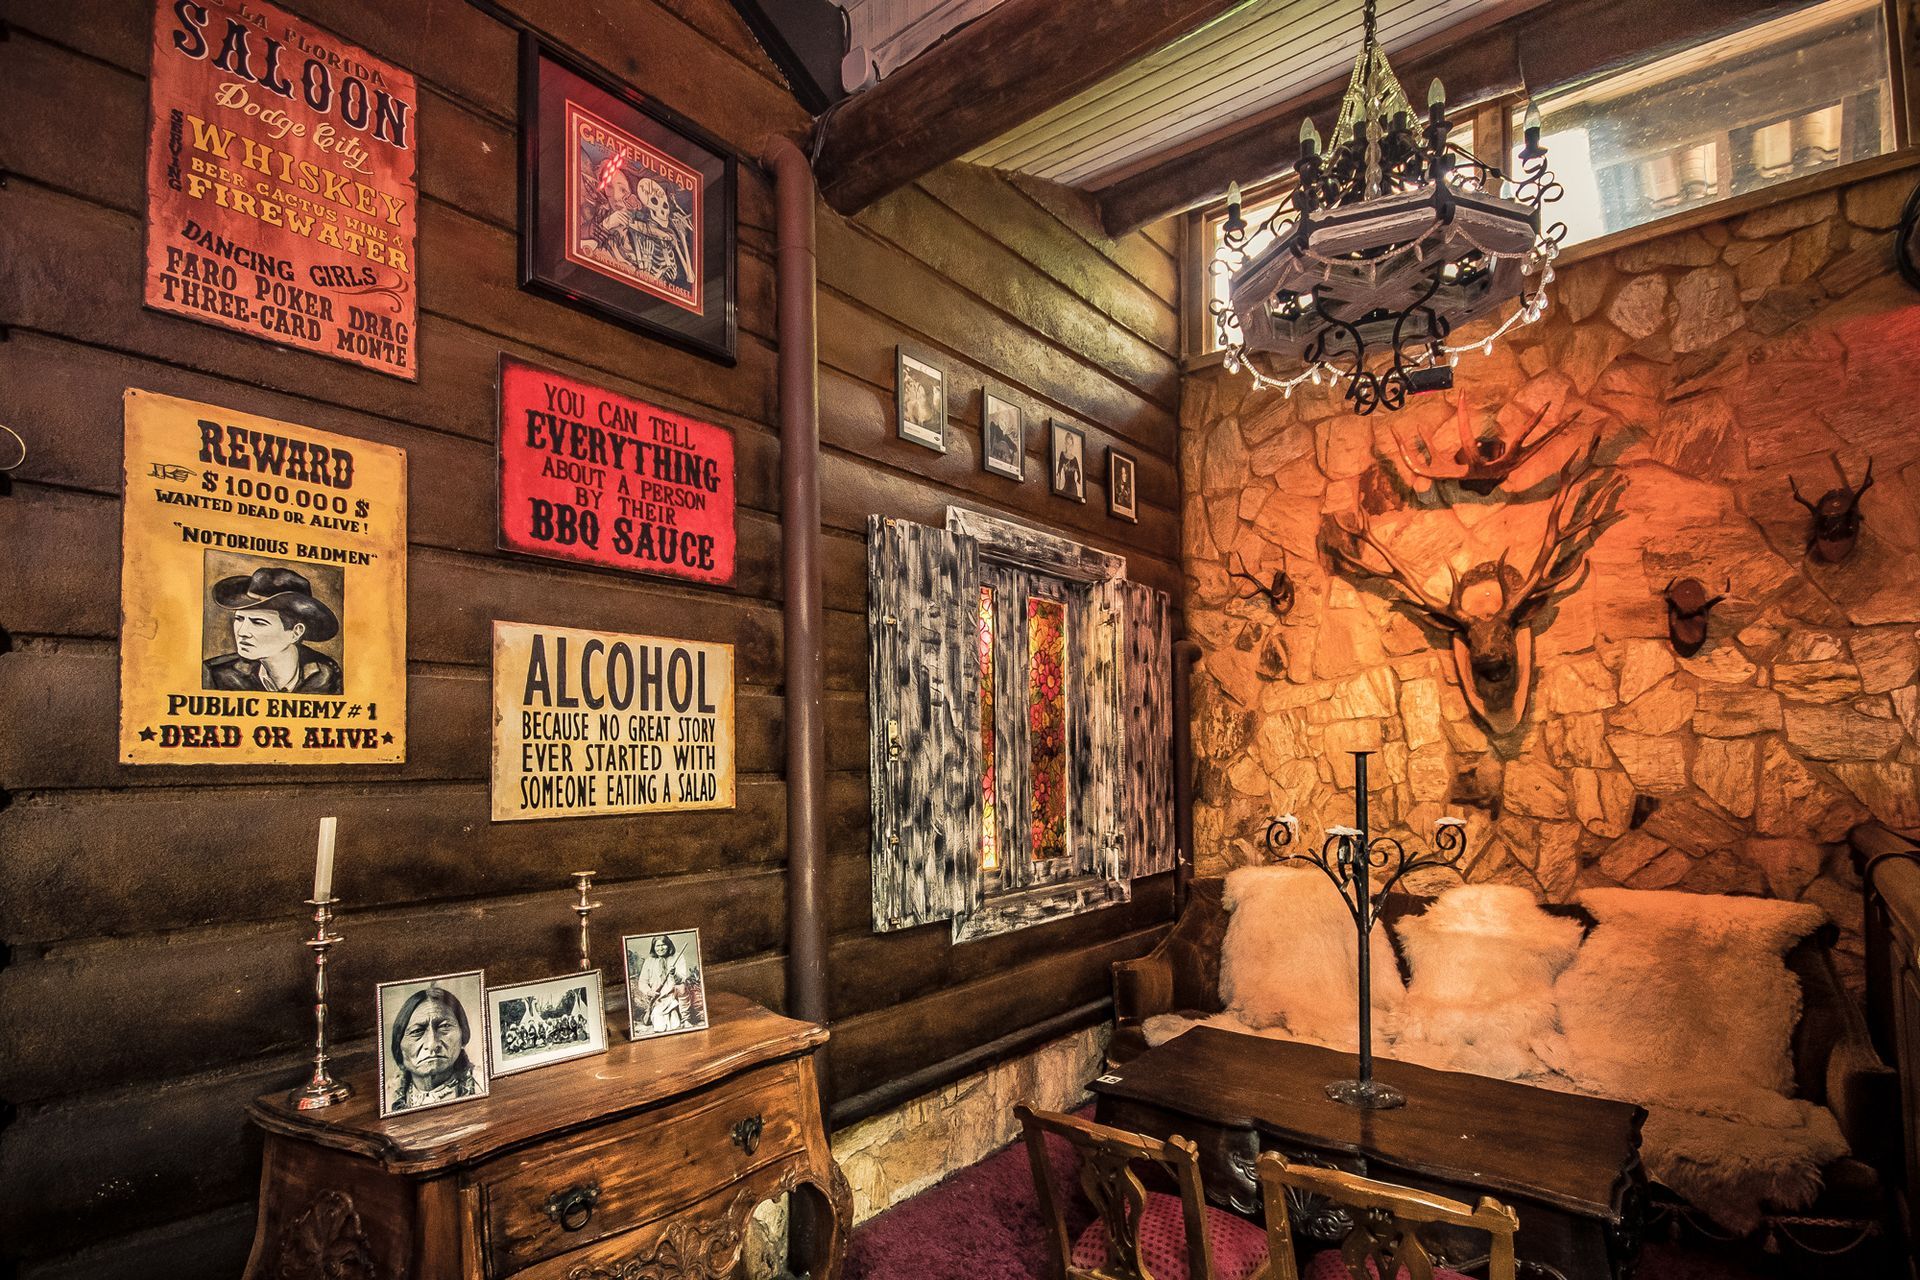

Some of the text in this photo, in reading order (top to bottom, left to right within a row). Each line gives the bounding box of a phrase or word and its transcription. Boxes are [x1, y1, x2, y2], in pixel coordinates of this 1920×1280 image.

[172, 0, 412, 149] SALOON
[240, 4, 388, 87] LA FLORIDA
[168, 108, 184, 192] SERVING
[214, 82, 374, 175] Dodge City
[579, 123, 693, 191] GRATEFUL DEAD
[187, 114, 406, 227] WHISKEY
[191, 157, 246, 188] BEER
[256, 183, 339, 222] CACTUS
[344, 215, 388, 242] WINE
[181, 219, 377, 287] DANCING GIRLS
[187, 173, 410, 274] FIREWATER
[159, 272, 407, 368] THREE-CARD MONTE
[166, 246, 409, 345] FARO POKER DRAG
[525, 409, 721, 493] EVERYTHING
[544, 383, 696, 450] YOU CAN TELL
[197, 419, 355, 490] REWARD
[541, 456, 706, 511] ABOUT A PERSON
[154, 488, 232, 513] WANTED
[237, 502, 279, 520] DEAD
[283, 510, 305, 524] OR
[528, 497, 715, 571] BBQ SAUCE
[575, 486, 677, 526] BY THEIR
[167, 694, 259, 717] PUBLIC
[266, 698, 347, 719] ENEMY
[523, 634, 716, 714] ALCOHOL
[158, 725, 379, 749] DEAD OR ALIVE
[522, 711, 716, 743] BECAUSE NO GREAT STORY
[522, 743, 716, 773] EVER STARTED WITH
[520, 772, 717, 810] SOMEONE EATING A SALAD
